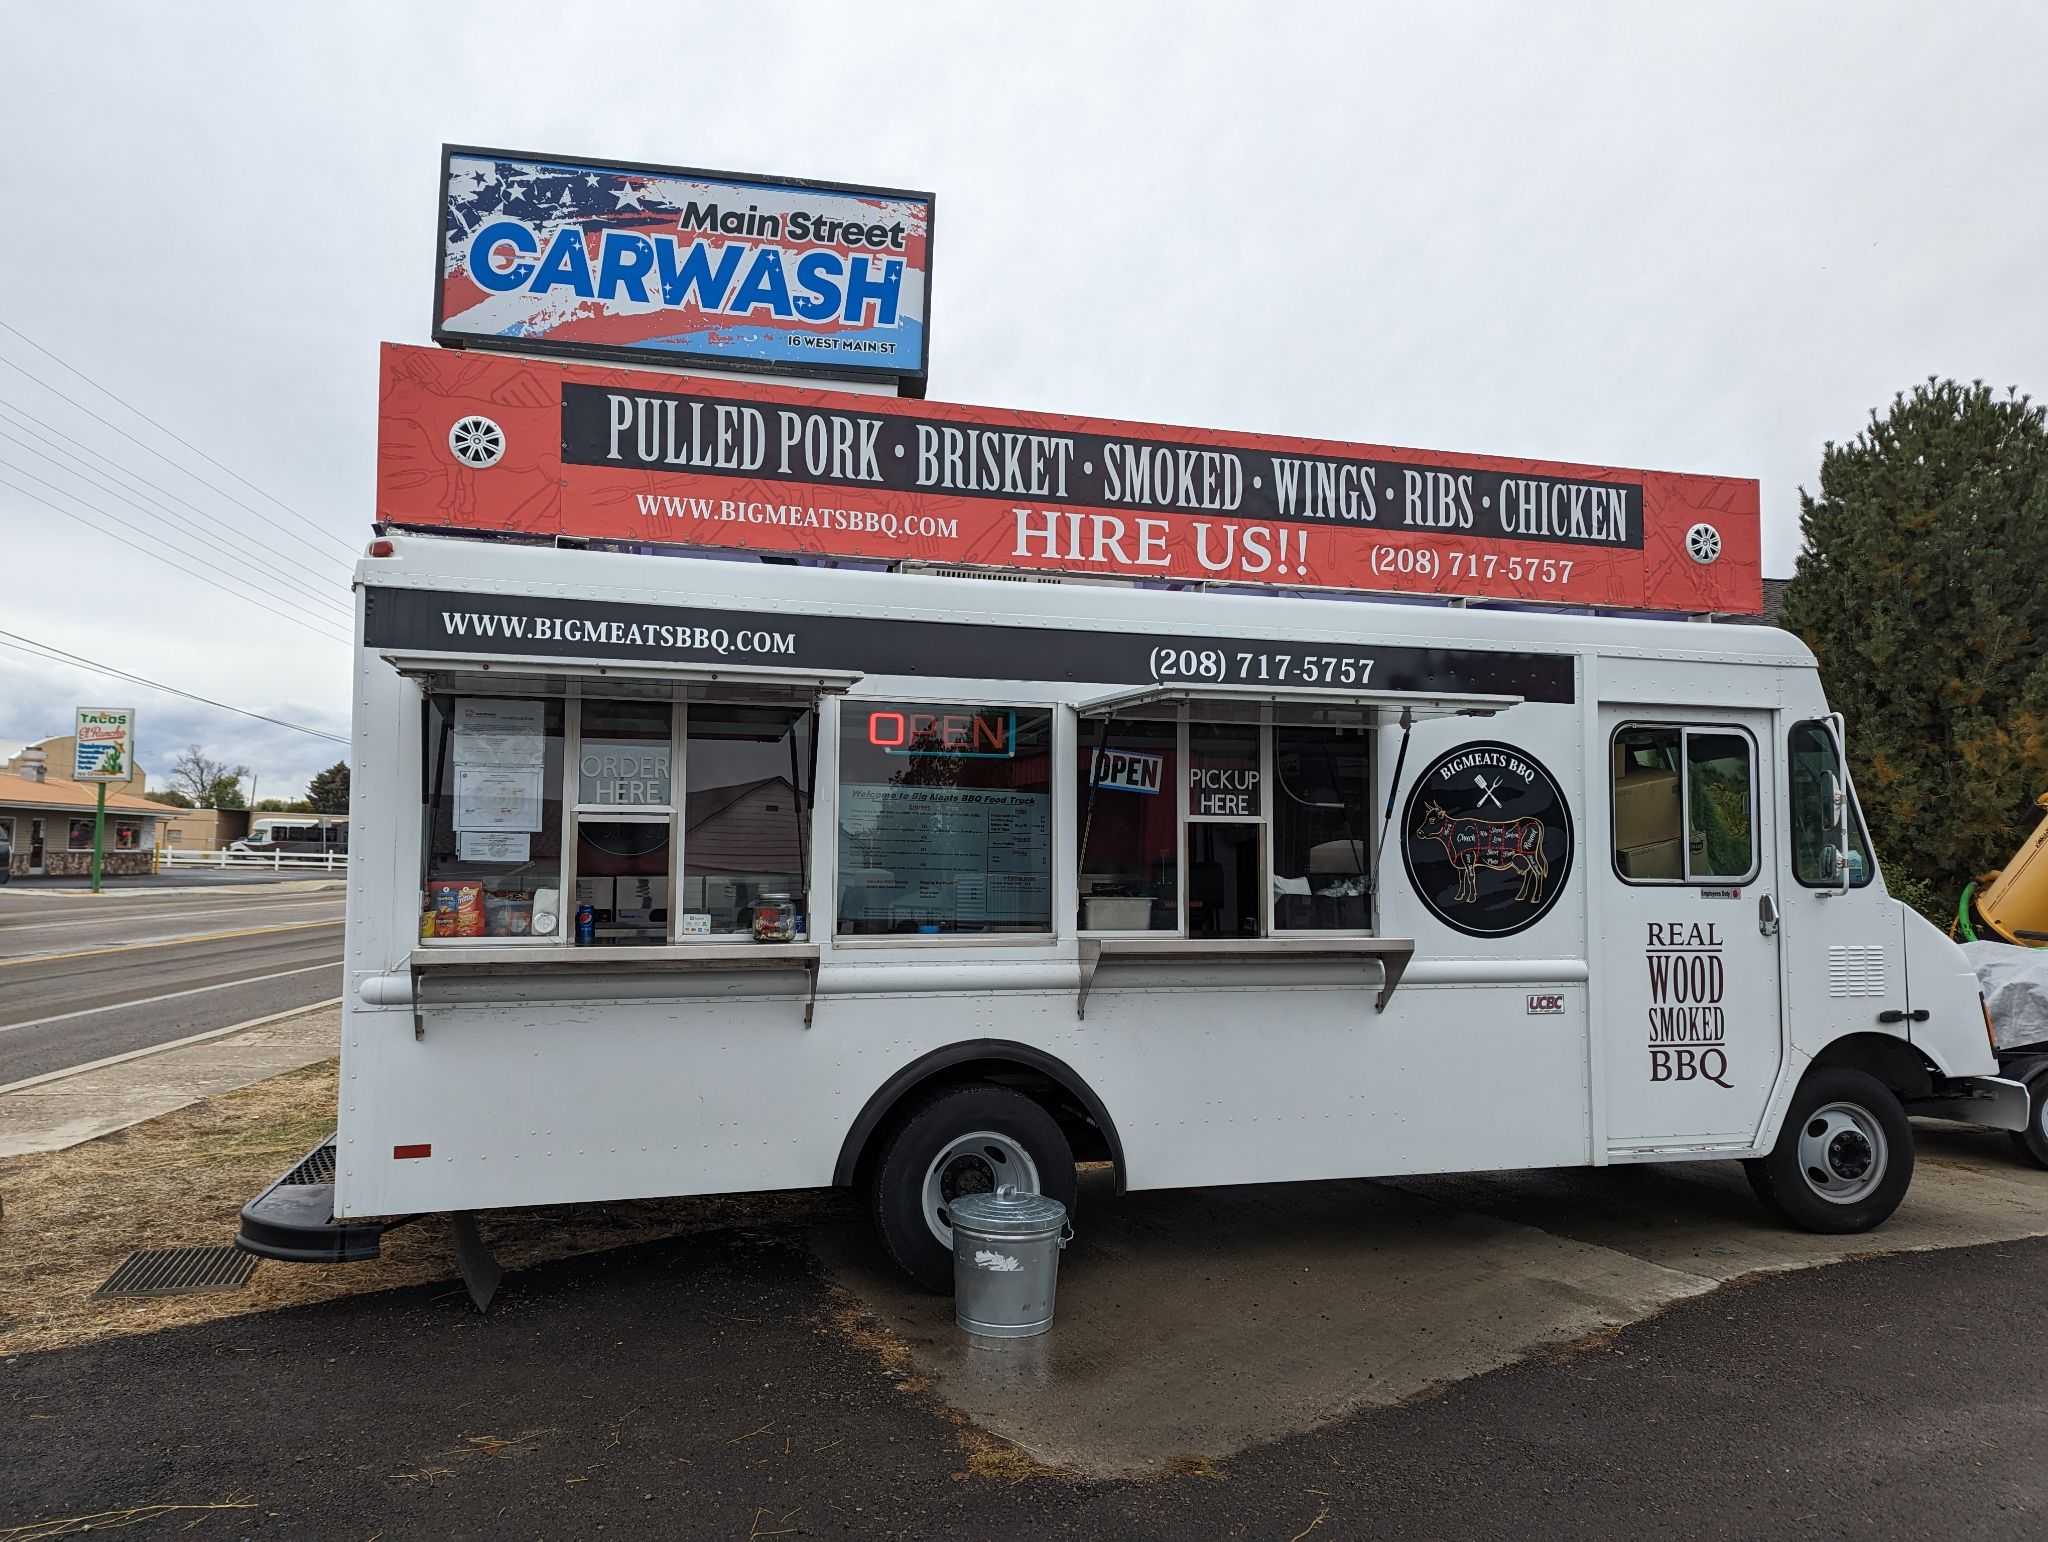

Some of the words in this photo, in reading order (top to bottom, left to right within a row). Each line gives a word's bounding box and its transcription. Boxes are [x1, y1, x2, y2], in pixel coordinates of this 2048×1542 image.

[679, 201, 779, 239] Main
[787, 210, 905, 249] Street
[468, 221, 904, 326] CARWASH
[788, 336, 801, 347] 16
[804, 337, 840, 350] WEST
[842, 340, 878, 352] MAIN
[881, 342, 896, 353] ST
[606, 394, 766, 472] PULLED
[778, 410, 885, 482] PORK
[915, 424, 1075, 498] BRISKET
[1104, 443, 1243, 512] SMOKED
[1271, 457, 1377, 522] WINGS
[1403, 469, 1474, 529] RIBS
[1499, 478, 1628, 542] CHICKEN
[637, 494, 959, 540] WWW.BIGMEATSBBQ.COM
[1011, 509, 1172, 566] HIRE
[1192, 522, 1308, 575] US!!
[1371, 544, 1440, 580] (208)
[1449, 551, 1575, 585] 717-5757
[441, 611, 796, 655] WWW.BIGMEATSBBQ.COM
[1149, 646, 1226, 683] (208)
[1236, 652, 1375, 684] 717-5757
[80, 713, 126, 724] TACOS
[868, 712, 1005, 749] OPEN
[581, 755, 669, 779] ORDER
[1095, 752, 1158, 788] OPEN
[1440, 752, 1506, 781] BIGMEATS
[1509, 757, 1536, 785] BBQ
[596, 779, 660, 804] HERE
[962, 794, 981, 803] BBQ
[1201, 794, 1249, 815] HERE
[1647, 923, 1723, 946] REAL
[1647, 955, 1724, 1004] WOOD
[1649, 1007, 1725, 1042] SMOKED
[1650, 1048, 1734, 1088] BBQ
